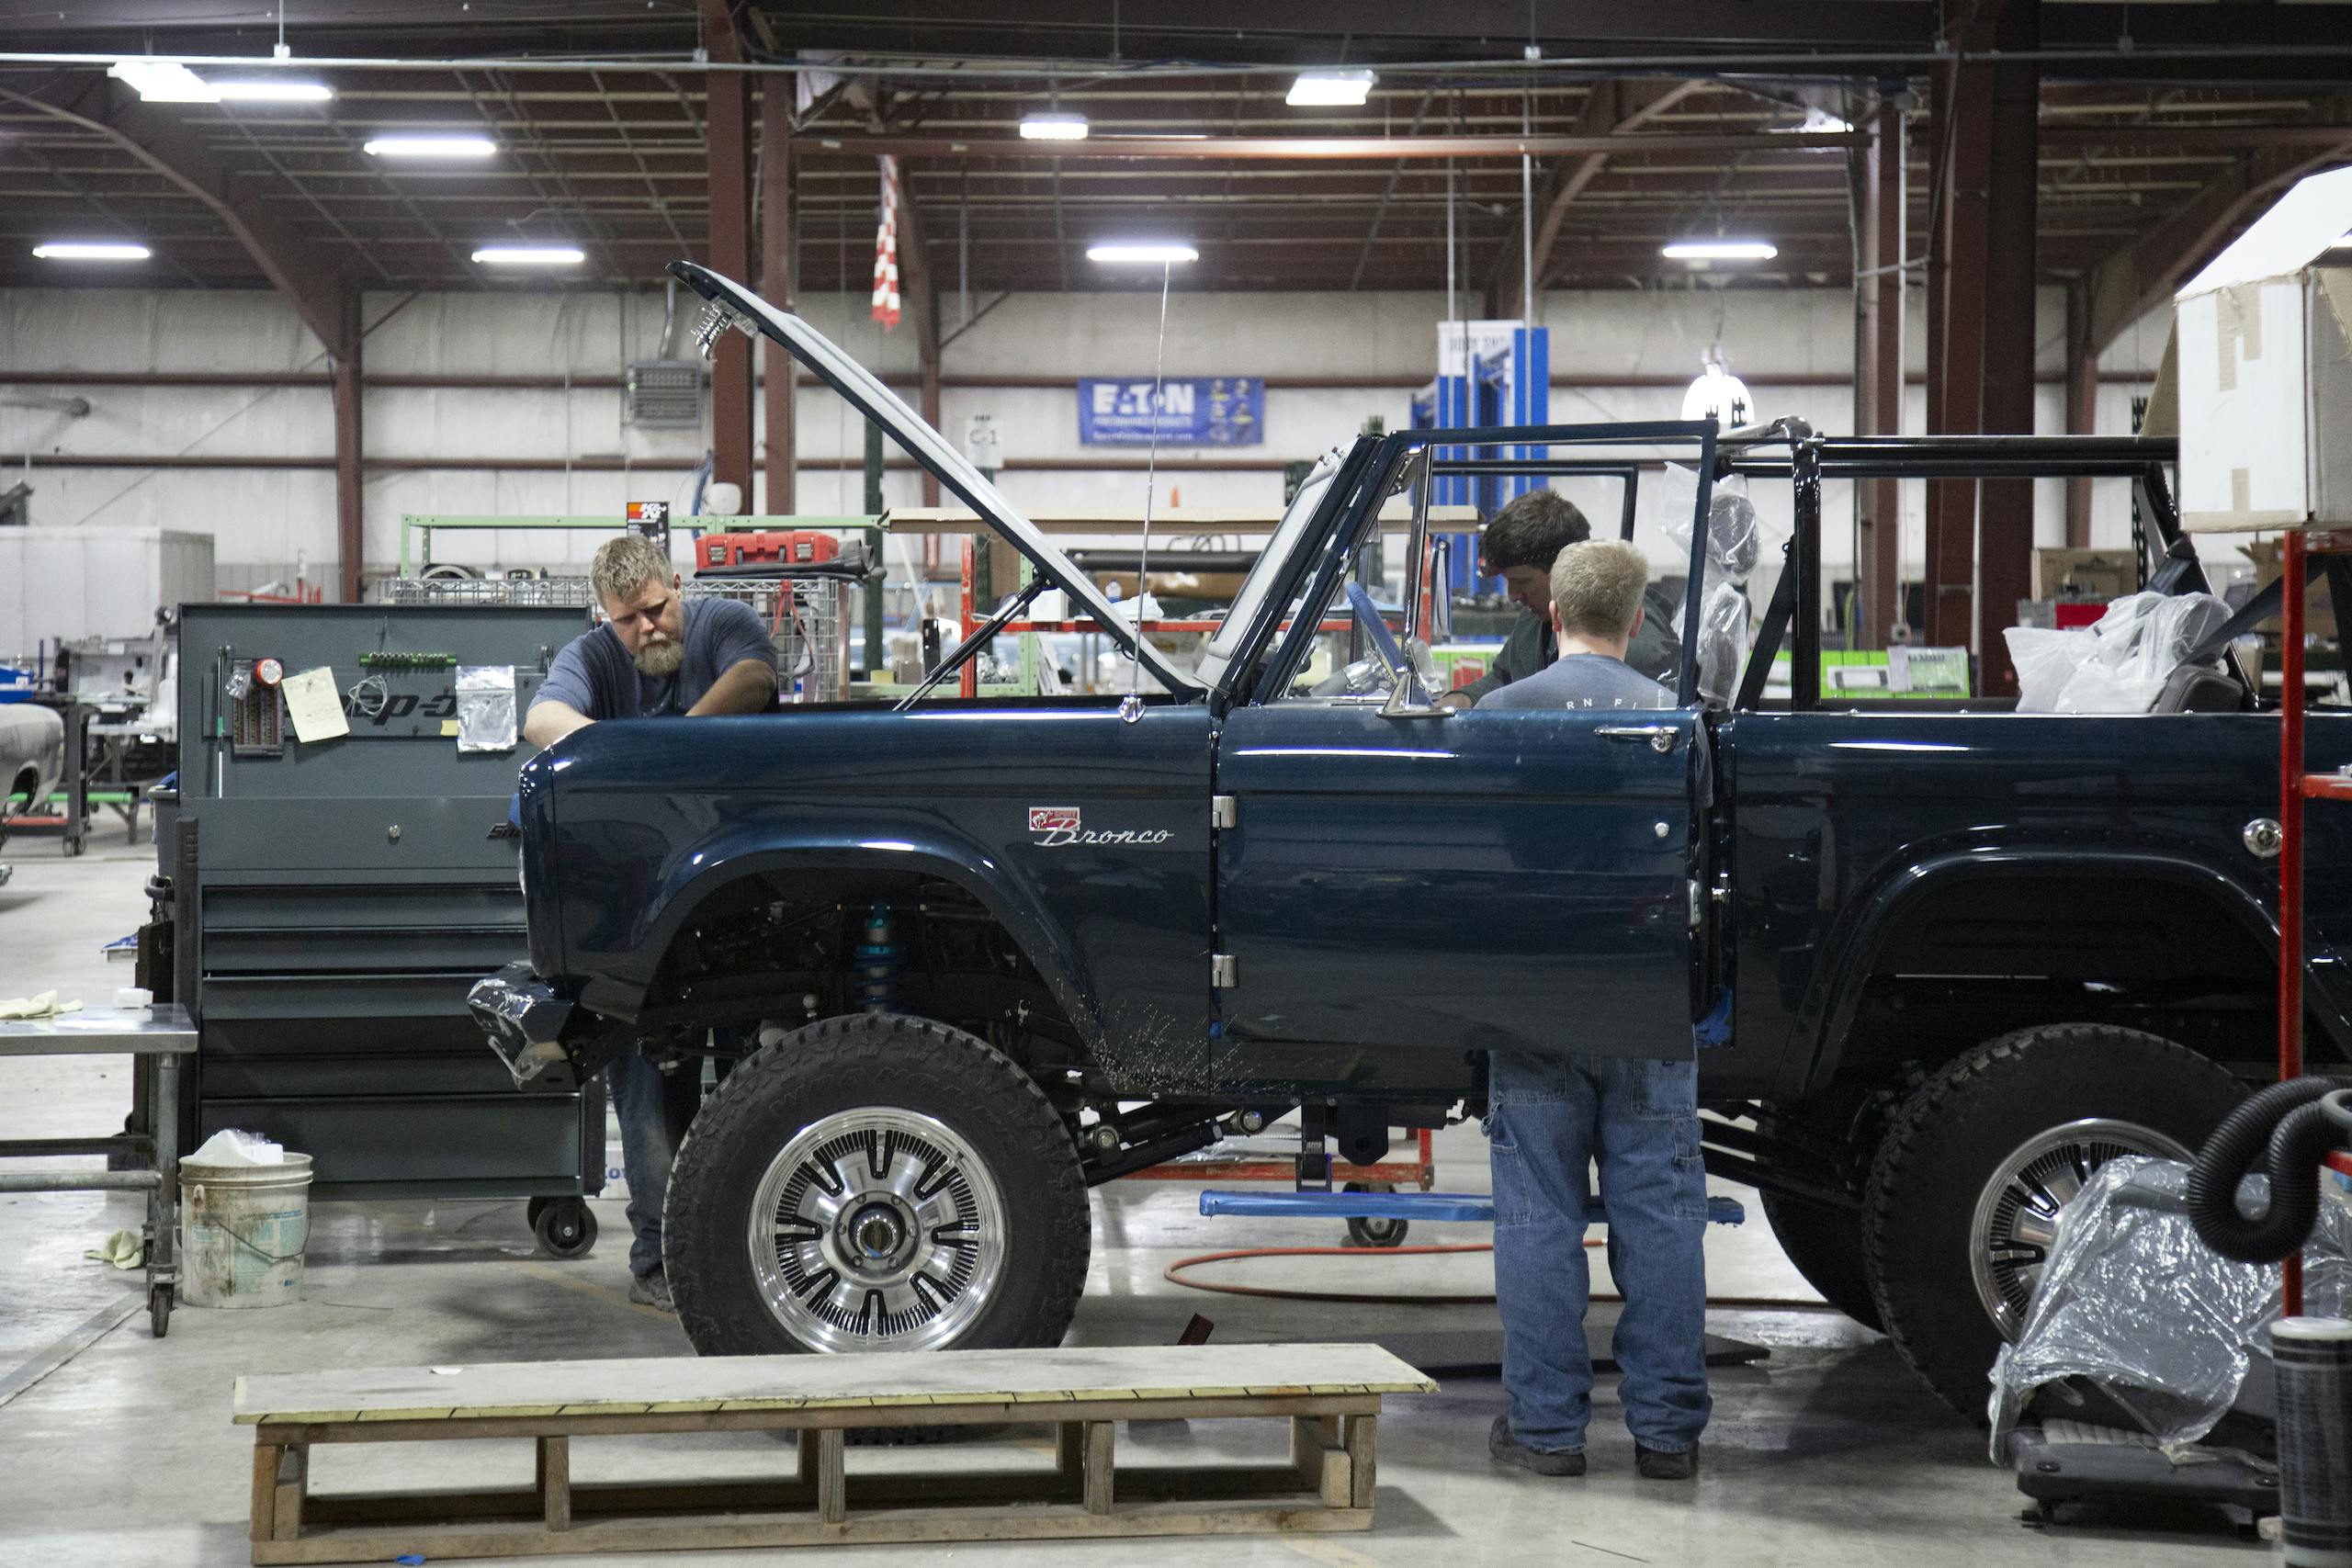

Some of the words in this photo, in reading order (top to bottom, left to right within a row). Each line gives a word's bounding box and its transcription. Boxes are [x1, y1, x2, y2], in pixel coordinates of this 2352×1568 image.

[1092, 383, 1195, 415] EATON
[968, 428, 997, 446] C-1
[1034, 817, 1175, 847] Bronco
